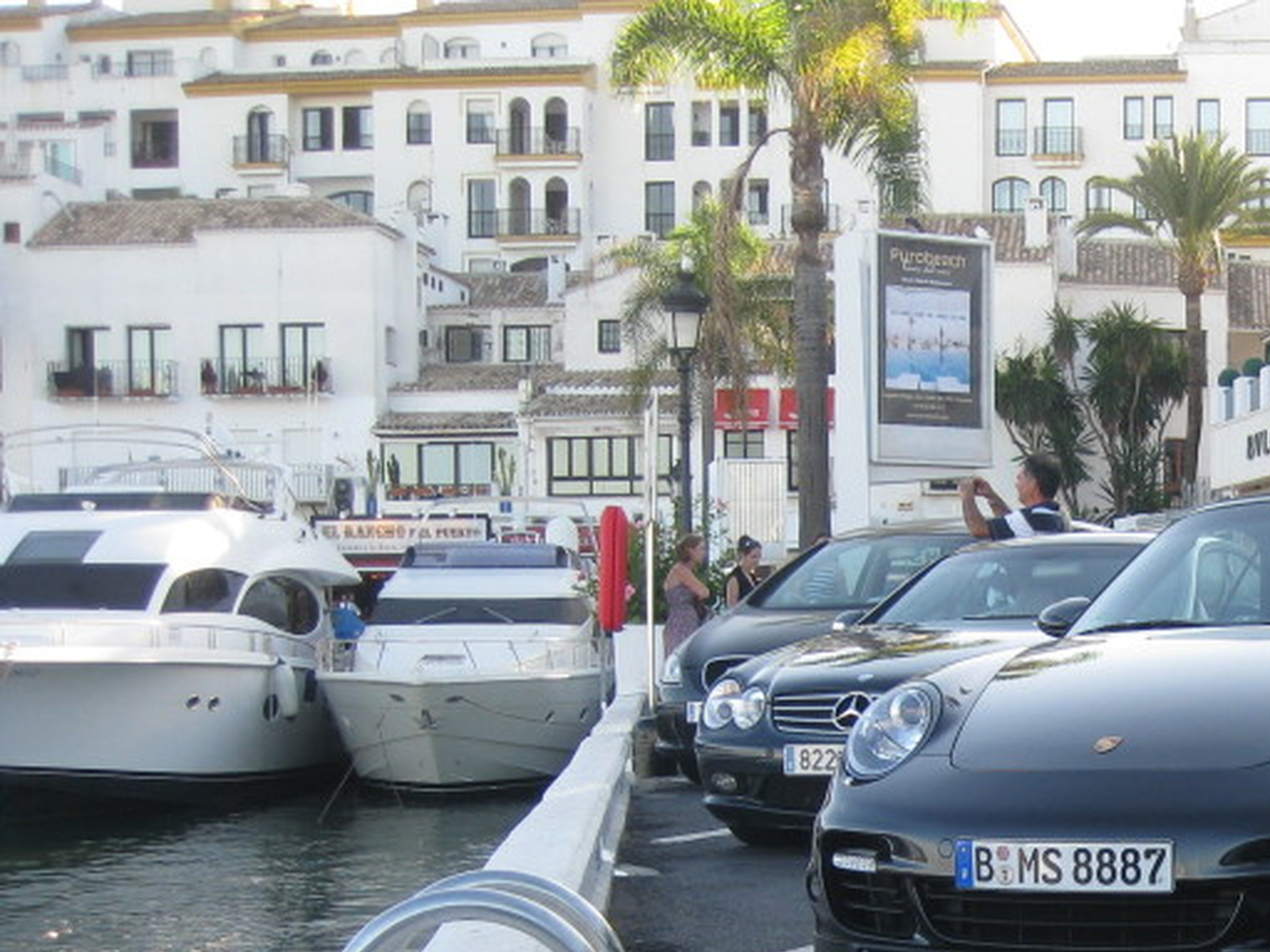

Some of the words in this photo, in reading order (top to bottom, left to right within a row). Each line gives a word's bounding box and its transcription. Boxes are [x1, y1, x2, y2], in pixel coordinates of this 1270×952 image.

[975, 847, 994, 882] B
[1018, 848, 1062, 884] MS
[1073, 848, 1166, 885] 8887
